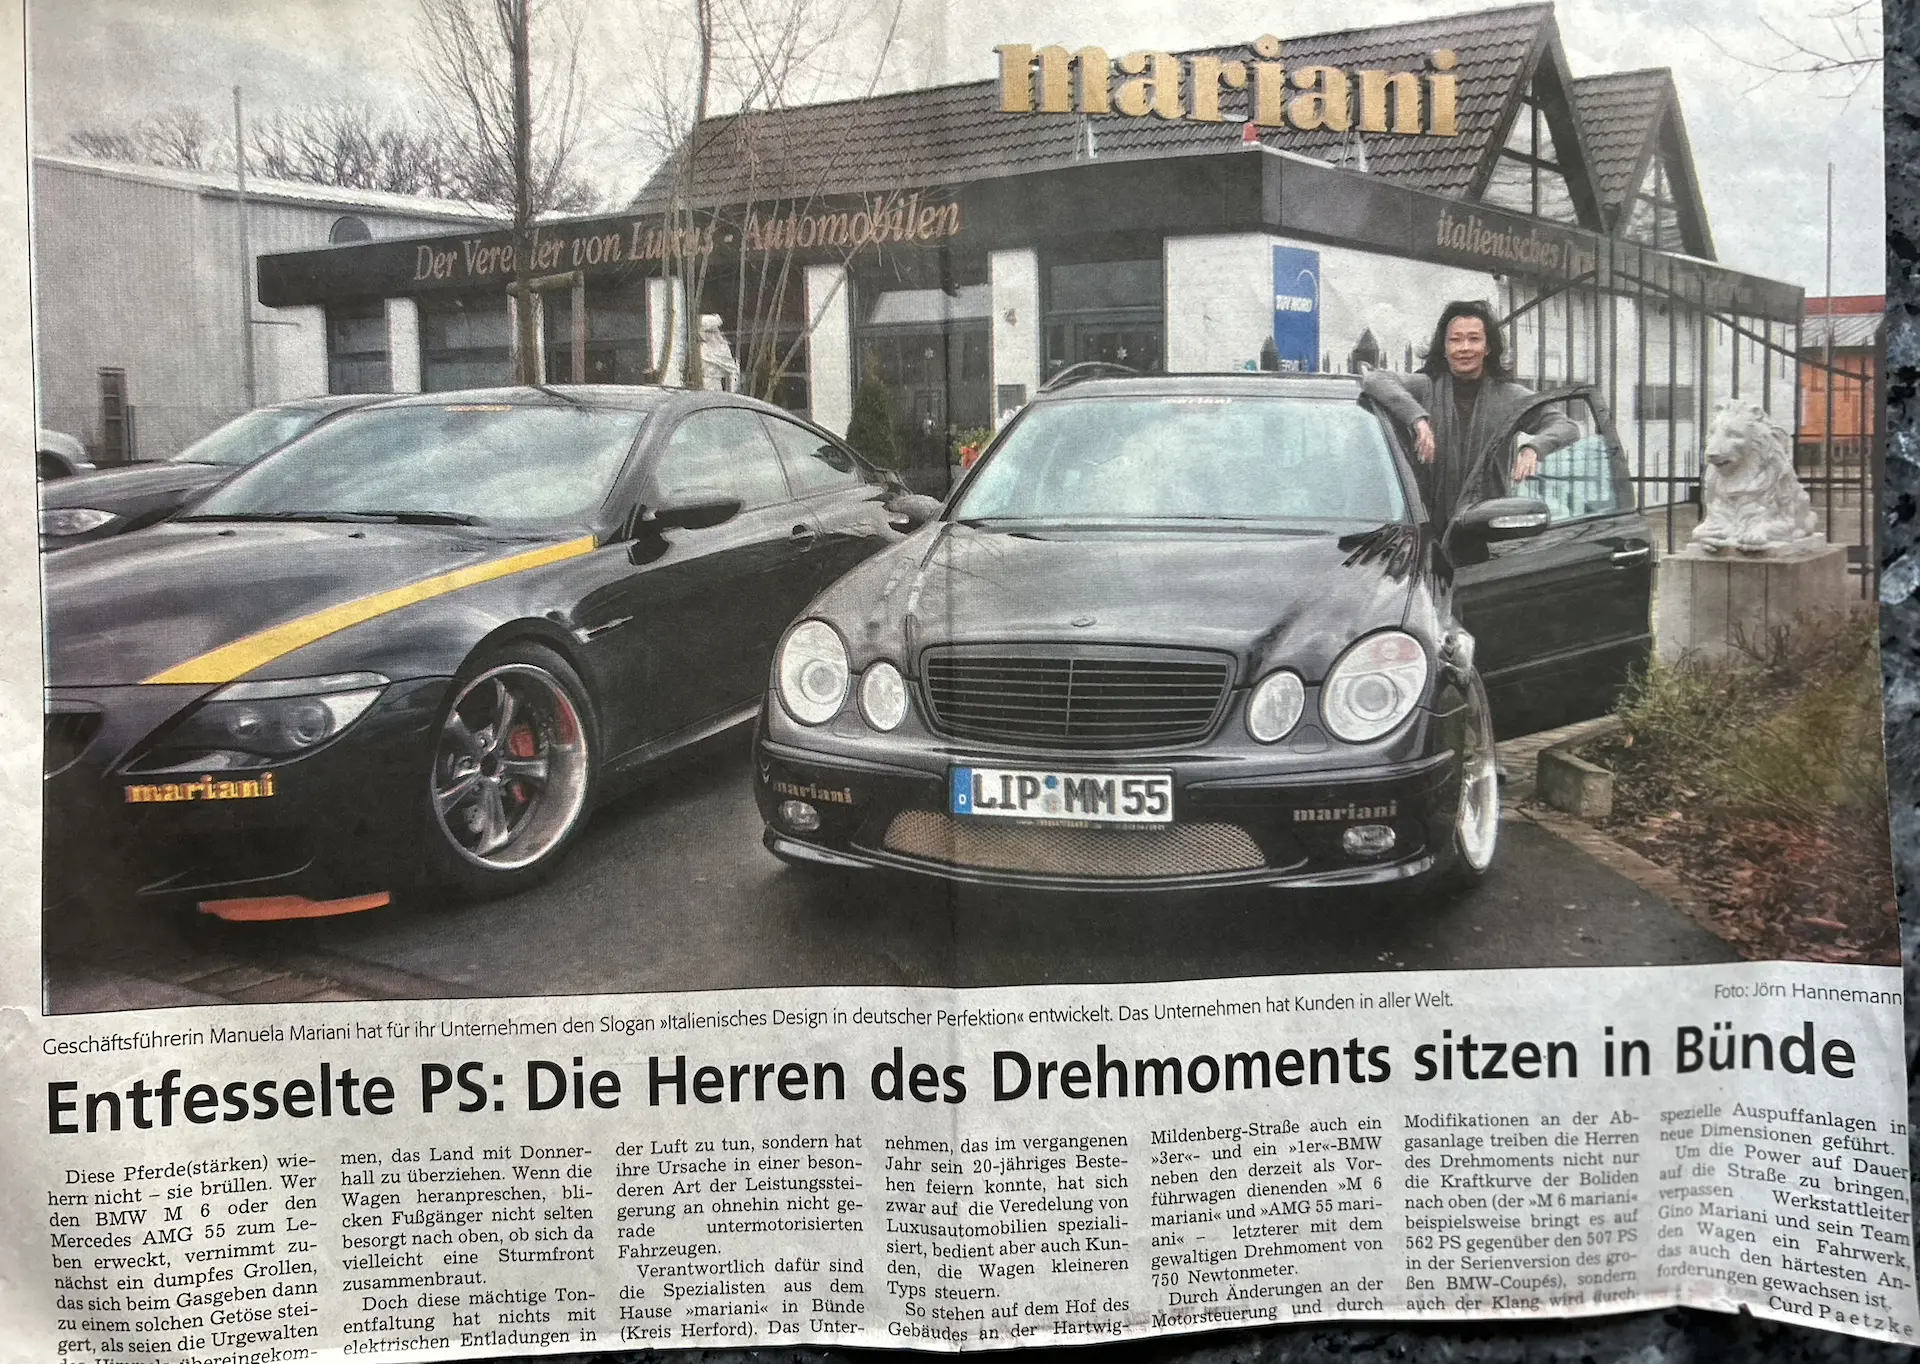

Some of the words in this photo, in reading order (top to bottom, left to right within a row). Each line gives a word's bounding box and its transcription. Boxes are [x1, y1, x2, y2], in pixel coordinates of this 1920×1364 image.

[996, 34, 1460, 137] mariani
[414, 244, 458, 281] Der
[572, 230, 621, 265] von
[124, 771, 275, 804] mariani
[773, 782, 853, 804] mariani
[973, 773, 1041, 810] LIP
[1063, 777, 1116, 815] MM
[1122, 779, 1169, 815] 55
[1293, 799, 1397, 821] mariani
[1715, 984, 1748, 999] Foto:
[1753, 982, 1786, 997] Jörn
[1792, 983, 1901, 1004] Hannemann
[43, 1031, 203, 1055] Geschäftsführerin
[211, 1024, 284, 1044] Manuela
[290, 1023, 350, 1040] Mariani
[356, 1022, 382, 1039] hat
[387, 1021, 410, 1038] für
[414, 1021, 436, 1037] ihr
[441, 1018, 556, 1037] Unternehmen
[563, 1016, 594, 1033] den
[600, 1015, 654, 1036] Slogan
[660, 1009, 767, 1029] »Italienisches
[773, 1008, 827, 1029] Design
[834, 1007, 847, 1024] in
[853, 1007, 932, 1025] deutscher
[937, 1009, 1024, 1027] Perfektion«
[1029, 1004, 1113, 1023] entwickelt.
[1119, 1006, 1149, 1021] Das
[1155, 999, 1261, 1020] Unternehmen
[1266, 996, 1290, 1013] hat
[1295, 993, 1354, 1011] Kunden
[1360, 993, 1373, 1009] in
[1379, 992, 1411, 1008] aller
[1415, 990, 1453, 1007] Welt.
[48, 1062, 394, 1134] Entfesselte
[422, 1062, 504, 1113] PS:
[528, 1056, 621, 1111] Die
[649, 1055, 844, 1106] Herren
[871, 1046, 966, 1104] des
[994, 1045, 1391, 1102] Drehmoments
[1415, 1029, 1577, 1081] sitzen
[1604, 1026, 1650, 1077] in
[1677, 1021, 1855, 1078] Bünde
[1151, 1119, 1299, 1144] Mildenberg-Straße
[1310, 1117, 1347, 1132] auch
[1358, 1116, 1382, 1130] ein
[1404, 1113, 1529, 1128] Modifikationen
[1541, 1116, 1560, 1126] an
[1573, 1111, 1598, 1125] der
[1610, 1110, 1639, 1124] Ab-
[1660, 1104, 1721, 1124] spezielle
[1732, 1102, 1877, 1132] Auspuffanlagen
[1890, 1120, 1906, 1135] in
[616, 1142, 643, 1156] der
[651, 1139, 688, 1154] Luft
[695, 1142, 715, 1152] zu
[722, 1138, 754, 1153] tun,
[762, 1134, 828, 1149] sondern
[835, 1134, 862, 1148] hat
[885, 1135, 953, 1155] nehmen,
[961, 1138, 988, 1153] das
[995, 1137, 1016, 1151] im
[1022, 1136, 1128, 1152] vergangenen
[1212, 1144, 1242, 1160] und
[1253, 1145, 1277, 1156] ein
[1289, 1136, 1382, 1153] »1er«-BMW
[1660, 1129, 1693, 1141] neue
[1701, 1124, 1812, 1145] Dimensionen
[1822, 1135, 1894, 1155] geführt.
[341, 1153, 381, 1166] men,
[392, 1148, 420, 1162] das
[429, 1146, 474, 1161] Land
[483, 1146, 511, 1160] mit
[520, 1145, 592, 1159] Donner-
[885, 1156, 922, 1171] Jahr
[931, 1160, 963, 1174] sein
[974, 1156, 1065, 1175] 20-jähriges
[1076, 1155, 1128, 1168] Beste-
[1405, 1155, 1430, 1168] des
[1440, 1154, 1554, 1168] Drehmoments
[1563, 1152, 1604, 1166] nicht
[1613, 1153, 1640, 1164] nur
[65, 1170, 115, 1184] Diese
[124, 1154, 268, 1181] Pferde(stärken)
[277, 1157, 316, 1168] wie-
[1405, 1175, 1429, 1188] die
[1440, 1174, 1532, 1188] Kraftkurve
[1543, 1173, 1569, 1186] der
[1580, 1170, 1639, 1186] Boliden
[47, 1191, 89, 1205] hern
[95, 1188, 142, 1204] nicht
[167, 1184, 192, 1200] sie
[200, 1178, 272, 1196] brüllen.
[280, 1175, 317, 1189] Wer
[617, 1183, 664, 1197] deren
[672, 1181, 701, 1194] Art
[710, 1178, 737, 1192] der
[745, 1176, 862, 1193] Leistungsstei-
[342, 1213, 383, 1228] cken
[392, 1209, 483, 1227] Fußgänger
[492, 1207, 535, 1221] nicht
[544, 1206, 593, 1220] selten
[886, 1218, 1047, 1237] Luxusautomobilien
[1058, 1215, 1128, 1235] speziali-
[1658, 1206, 1693, 1219] Gino
[1700, 1202, 1767, 1224] Mariani
[1775, 1215, 1810, 1230] und
[1817, 1222, 1854, 1237] sein
[1861, 1224, 1909, 1246] Team
[50, 1233, 131, 1248] Mercedes
[142, 1227, 193, 1245] AMG
[205, 1223, 225, 1239] 55
[237, 1223, 275, 1236] zum
[286, 1217, 317, 1231] Le-
[342, 1252, 423, 1270] vielleicht
[444, 1251, 478, 1264] eine
[499, 1247, 594, 1262] Sturmfront
[887, 1239, 927, 1258] siert,
[932, 1242, 994, 1258] bedient
[1000, 1241, 1036, 1255] aber
[1041, 1238, 1080, 1253] auch
[1086, 1237, 1128, 1251] Kun-
[1151, 1249, 1237, 1270] gewaltigen
[1244, 1238, 1347, 1258] Drehmoment
[1354, 1240, 1383, 1251] von
[54, 1276, 108, 1290] nächst
[117, 1276, 144, 1290] ein
[154, 1267, 233, 1288] dumpfes
[244, 1260, 317, 1278] Grollen,
[637, 1258, 765, 1278] Verantwortlich
[775, 1257, 820, 1272] dafür
[830, 1258, 864, 1273] sind
[1152, 1272, 1178, 1287] 750
[1188, 1264, 1298, 1284] Newtonmeter.
[362, 1294, 408, 1311] Doch
[418, 1293, 460, 1308] diese
[469, 1289, 546, 1306] mächtige
[555, 1288, 595, 1301] Ton-
[619, 1306, 672, 1319] Hause
[686, 1304, 768, 1316] »mariani«
[782, 1300, 798, 1313] in
[812, 1299, 864, 1313] Bünde
[1768, 1295, 1813, 1317] Curd
[621, 1325, 671, 1342] (Kreis
[681, 1321, 757, 1338] Herford).
[768, 1320, 799, 1334] Das
[810, 1319, 864, 1333] Unter-
